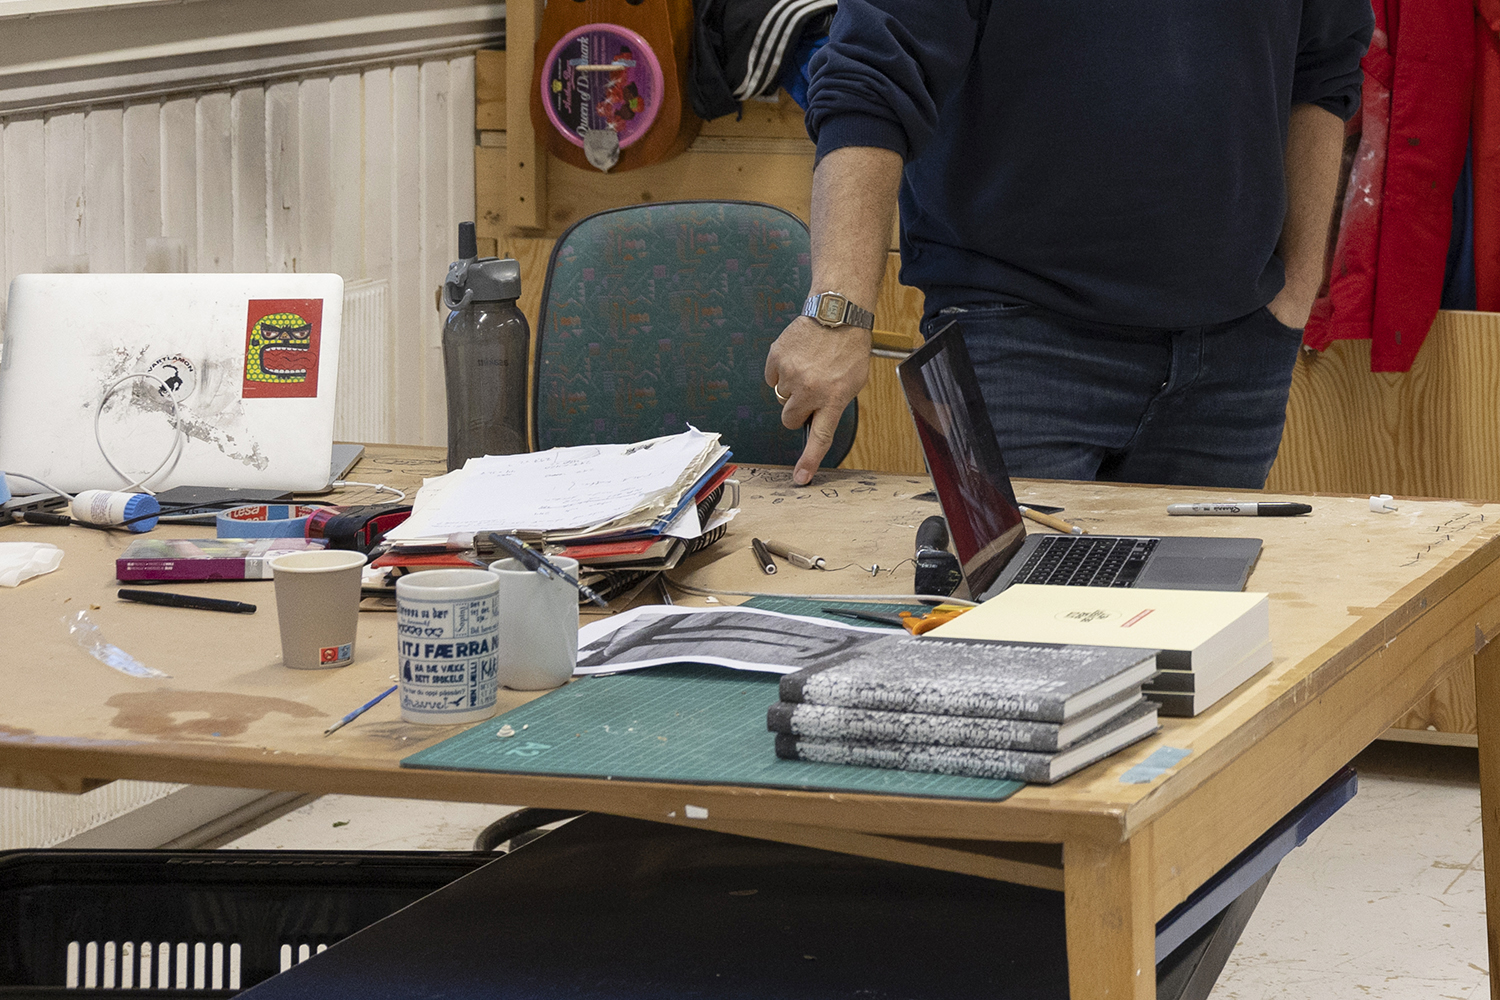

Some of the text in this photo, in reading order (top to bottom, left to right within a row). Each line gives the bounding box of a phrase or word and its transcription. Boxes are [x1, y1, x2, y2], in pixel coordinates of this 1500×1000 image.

[577, 89, 591, 101] of
[576, 103, 590, 138] Queen
[402, 640, 420, 657] ITJ
[424, 640, 489, 659] FÆRRA
